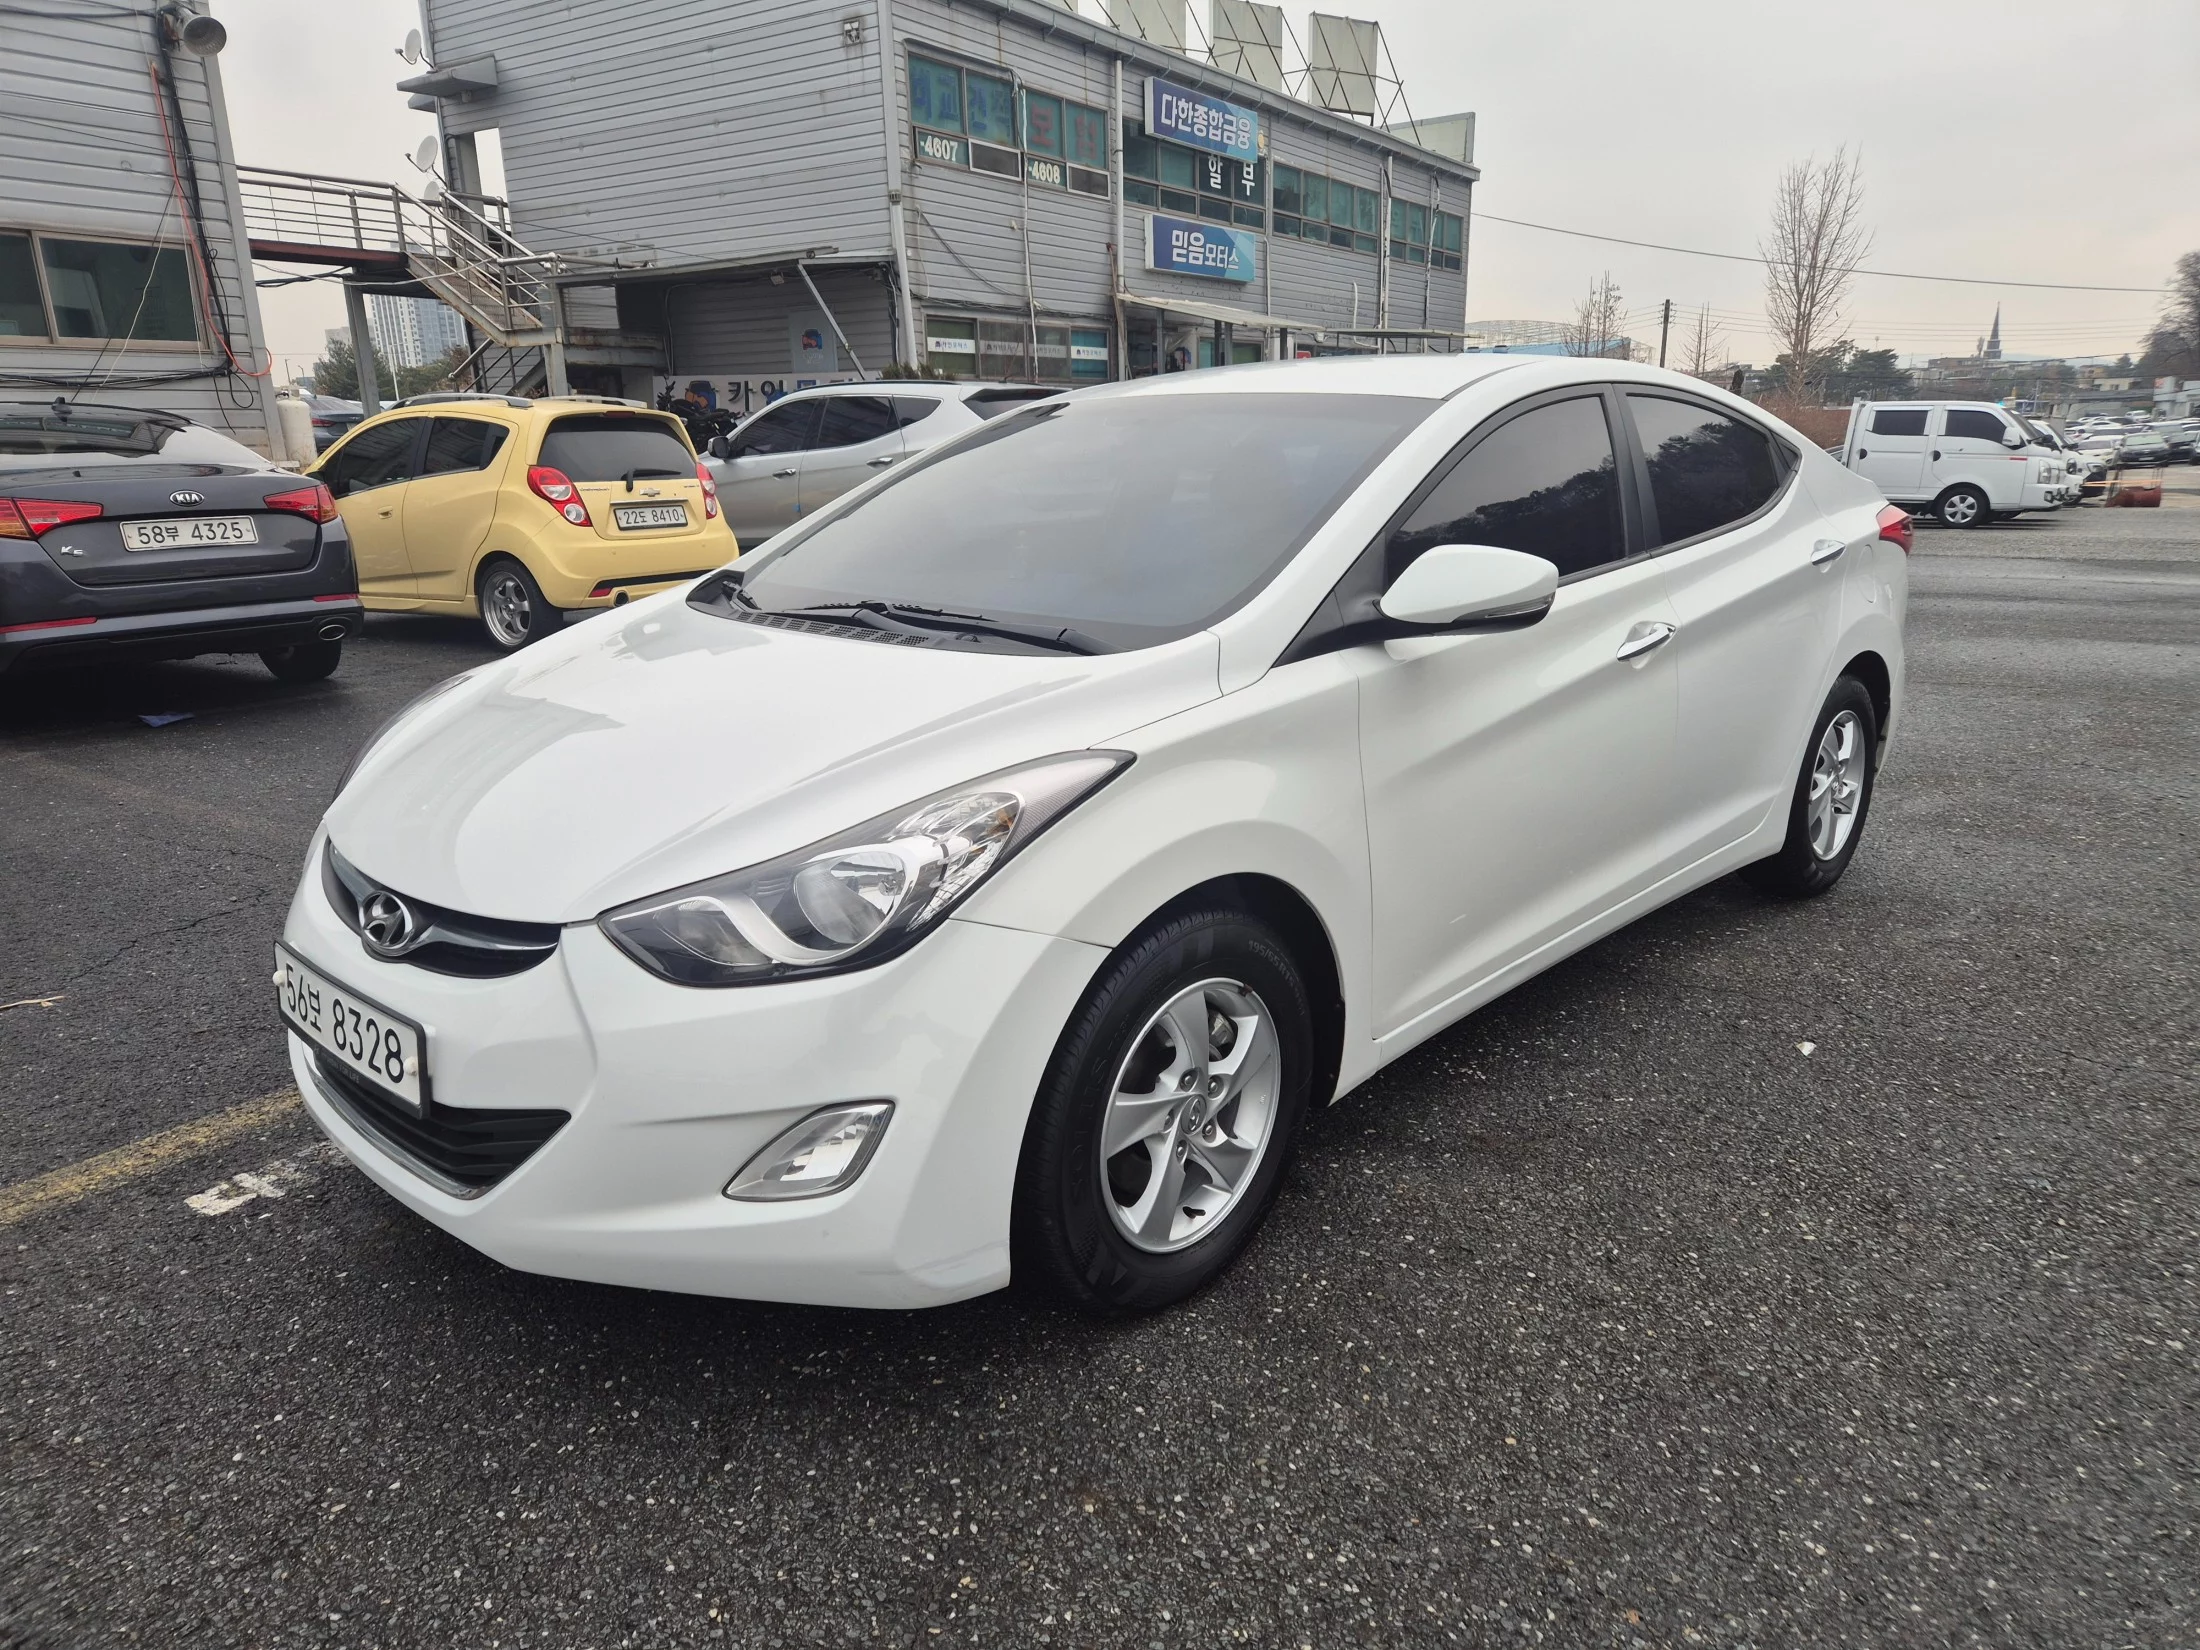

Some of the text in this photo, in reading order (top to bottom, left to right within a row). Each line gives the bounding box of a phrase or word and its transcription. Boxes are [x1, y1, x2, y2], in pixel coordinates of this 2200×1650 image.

[1160, 92, 1252, 151] 다한종합금융
[1171, 228, 1240, 271] 믿음모터스
[174, 492, 200, 504] KIA
[652, 508, 680, 523] 8410
[137, 522, 243, 545] 58부 4325
[286, 963, 322, 1033] 56보
[332, 998, 404, 1083] 8328
